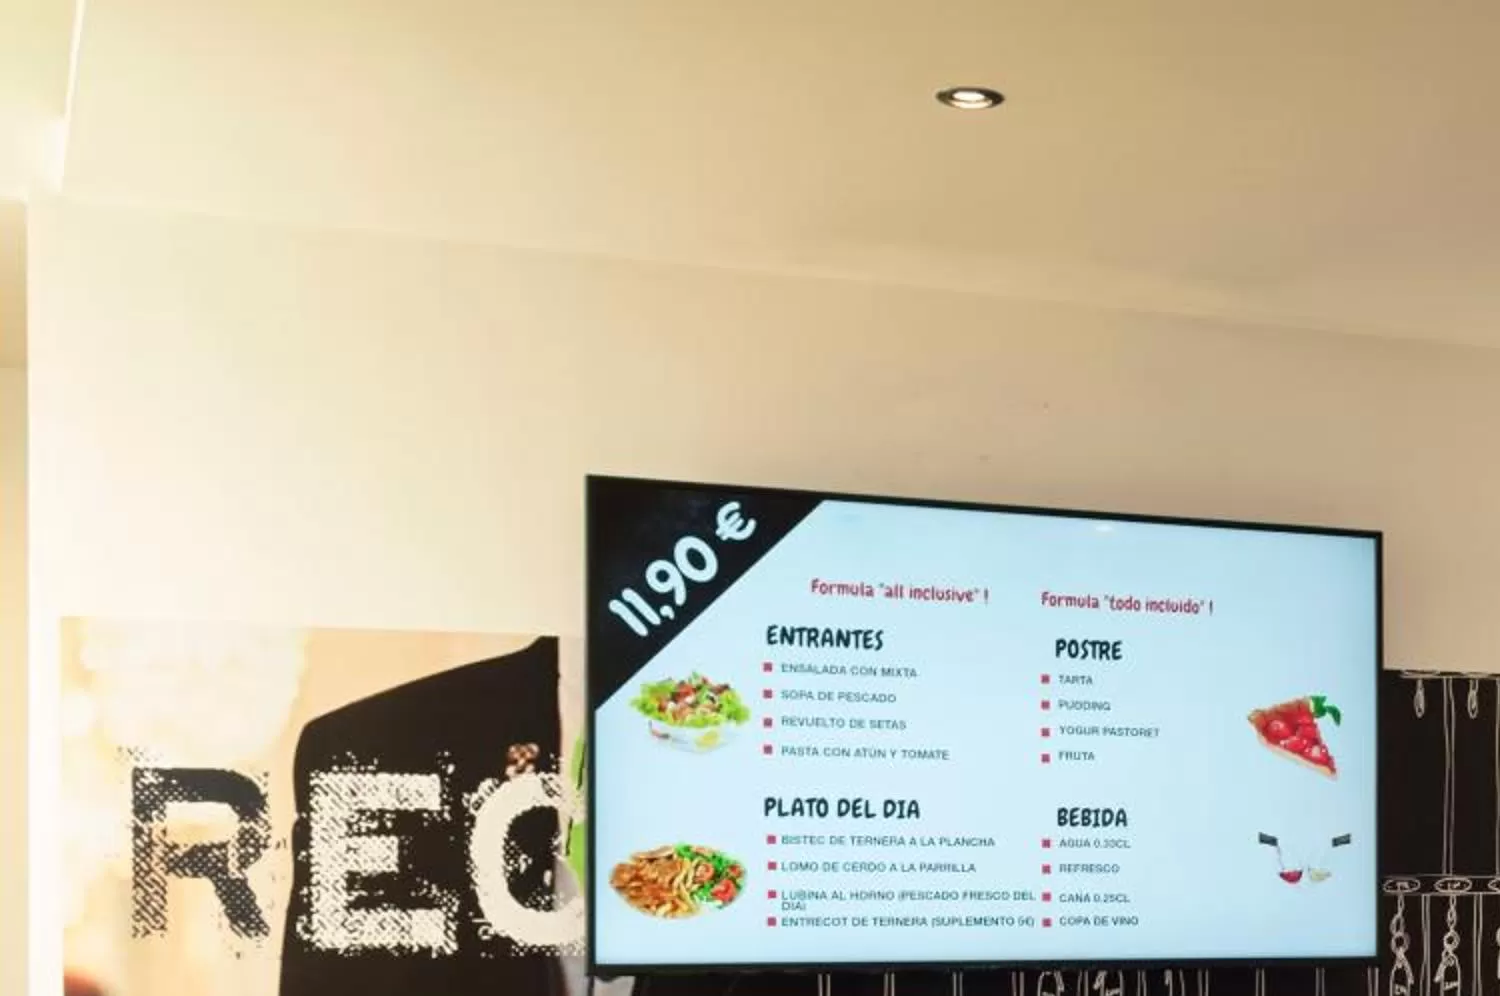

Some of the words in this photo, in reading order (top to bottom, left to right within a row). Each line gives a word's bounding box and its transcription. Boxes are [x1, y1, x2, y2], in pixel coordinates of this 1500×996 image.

[609, 535, 718, 637] 11,90
[715, 501, 756, 541] €
[811, 578, 874, 598] Formula
[1041, 591, 1100, 609] Formula
[766, 625, 884, 651] ENTRANTES
[1055, 638, 1123, 661] POSTRE
[781, 663, 847, 677] ENSALADA
[850, 666, 878, 677] CON
[881, 667, 918, 679] MIXTA
[1058, 675, 1093, 685] TARTA
[781, 689, 814, 701] SOPA
[817, 691, 835, 702] DE
[837, 692, 897, 704] PESCADO
[1058, 700, 1111, 711] PUDDING
[781, 716, 846, 729] REVUELTO
[849, 719, 865, 730] DE
[868, 719, 907, 731] SETAS
[1059, 725, 1100, 736] YOGUR
[1102, 726, 1160, 737] PASTORET
[781, 746, 819, 758] PASTA
[822, 747, 851, 759] CON
[889, 749, 897, 759] Y
[901, 749, 950, 761] TOMATE
[1058, 751, 1095, 761] FRUTA
[764, 798, 830, 818] PLATO
[837, 799, 877, 819] DEL
[883, 800, 921, 819] DIA
[1057, 807, 1128, 828] BEBIDA
[781, 835, 825, 846] BISTEC
[829, 836, 846, 846] DE
[850, 836, 906, 847] TERNERA
[908, 837, 918, 847] A
[920, 837, 936, 847] LA
[939, 837, 996, 848] PLANCHA
[1059, 838, 1091, 848] AGUA
[781, 862, 819, 872] LOMO
[822, 862, 840, 872] DE
[843, 862, 886, 873] CERDO
[888, 862, 898, 872] A
[901, 863, 917, 873] LA
[919, 863, 977, 873] PARRILLA
[1059, 863, 1121, 874] REFRESCO
[781, 890, 828, 901] LUBINA
[831, 890, 847, 901] AL
[850, 890, 894, 901] HORNO
[962, 890, 1011, 901] FRESCO
[1013, 891, 1037, 901] DEL
[781, 916, 848, 927] ENTRECOT
[851, 916, 869, 927] DE
[872, 916, 928, 927] TERNERA
[1059, 915, 1091, 926] COPA
[1093, 916, 1109, 926] DE
[1111, 916, 1139, 926] VINO
